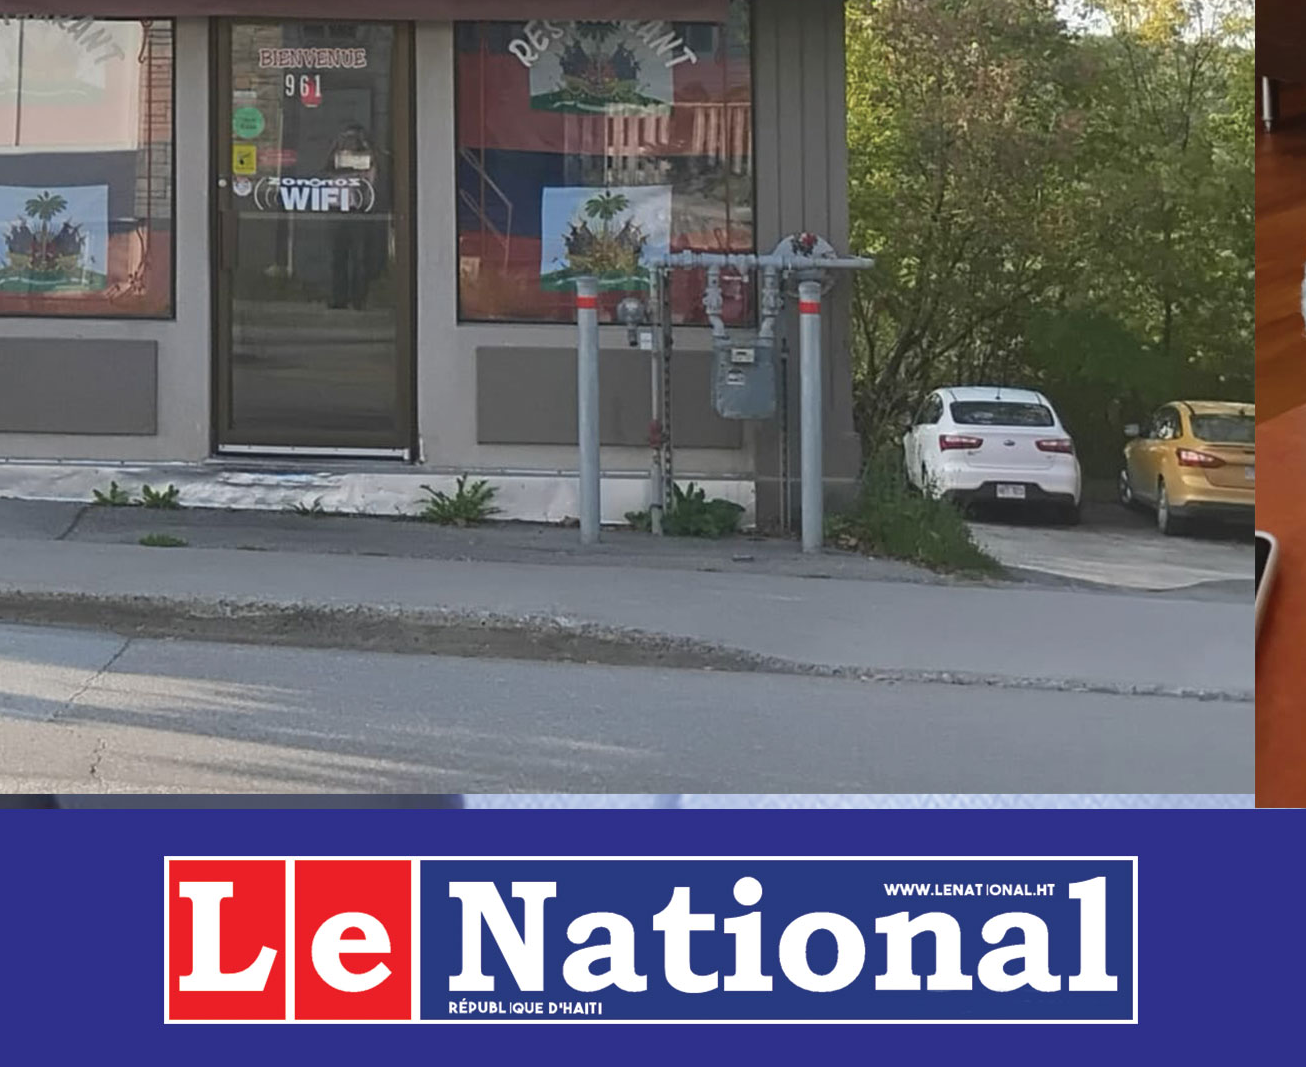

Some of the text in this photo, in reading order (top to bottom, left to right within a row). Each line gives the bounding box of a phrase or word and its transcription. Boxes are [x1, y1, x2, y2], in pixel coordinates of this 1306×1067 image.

[259, 49, 367, 68] BIENVENUE
[285, 74, 322, 97] 961
[280, 187, 349, 212] WIFI
